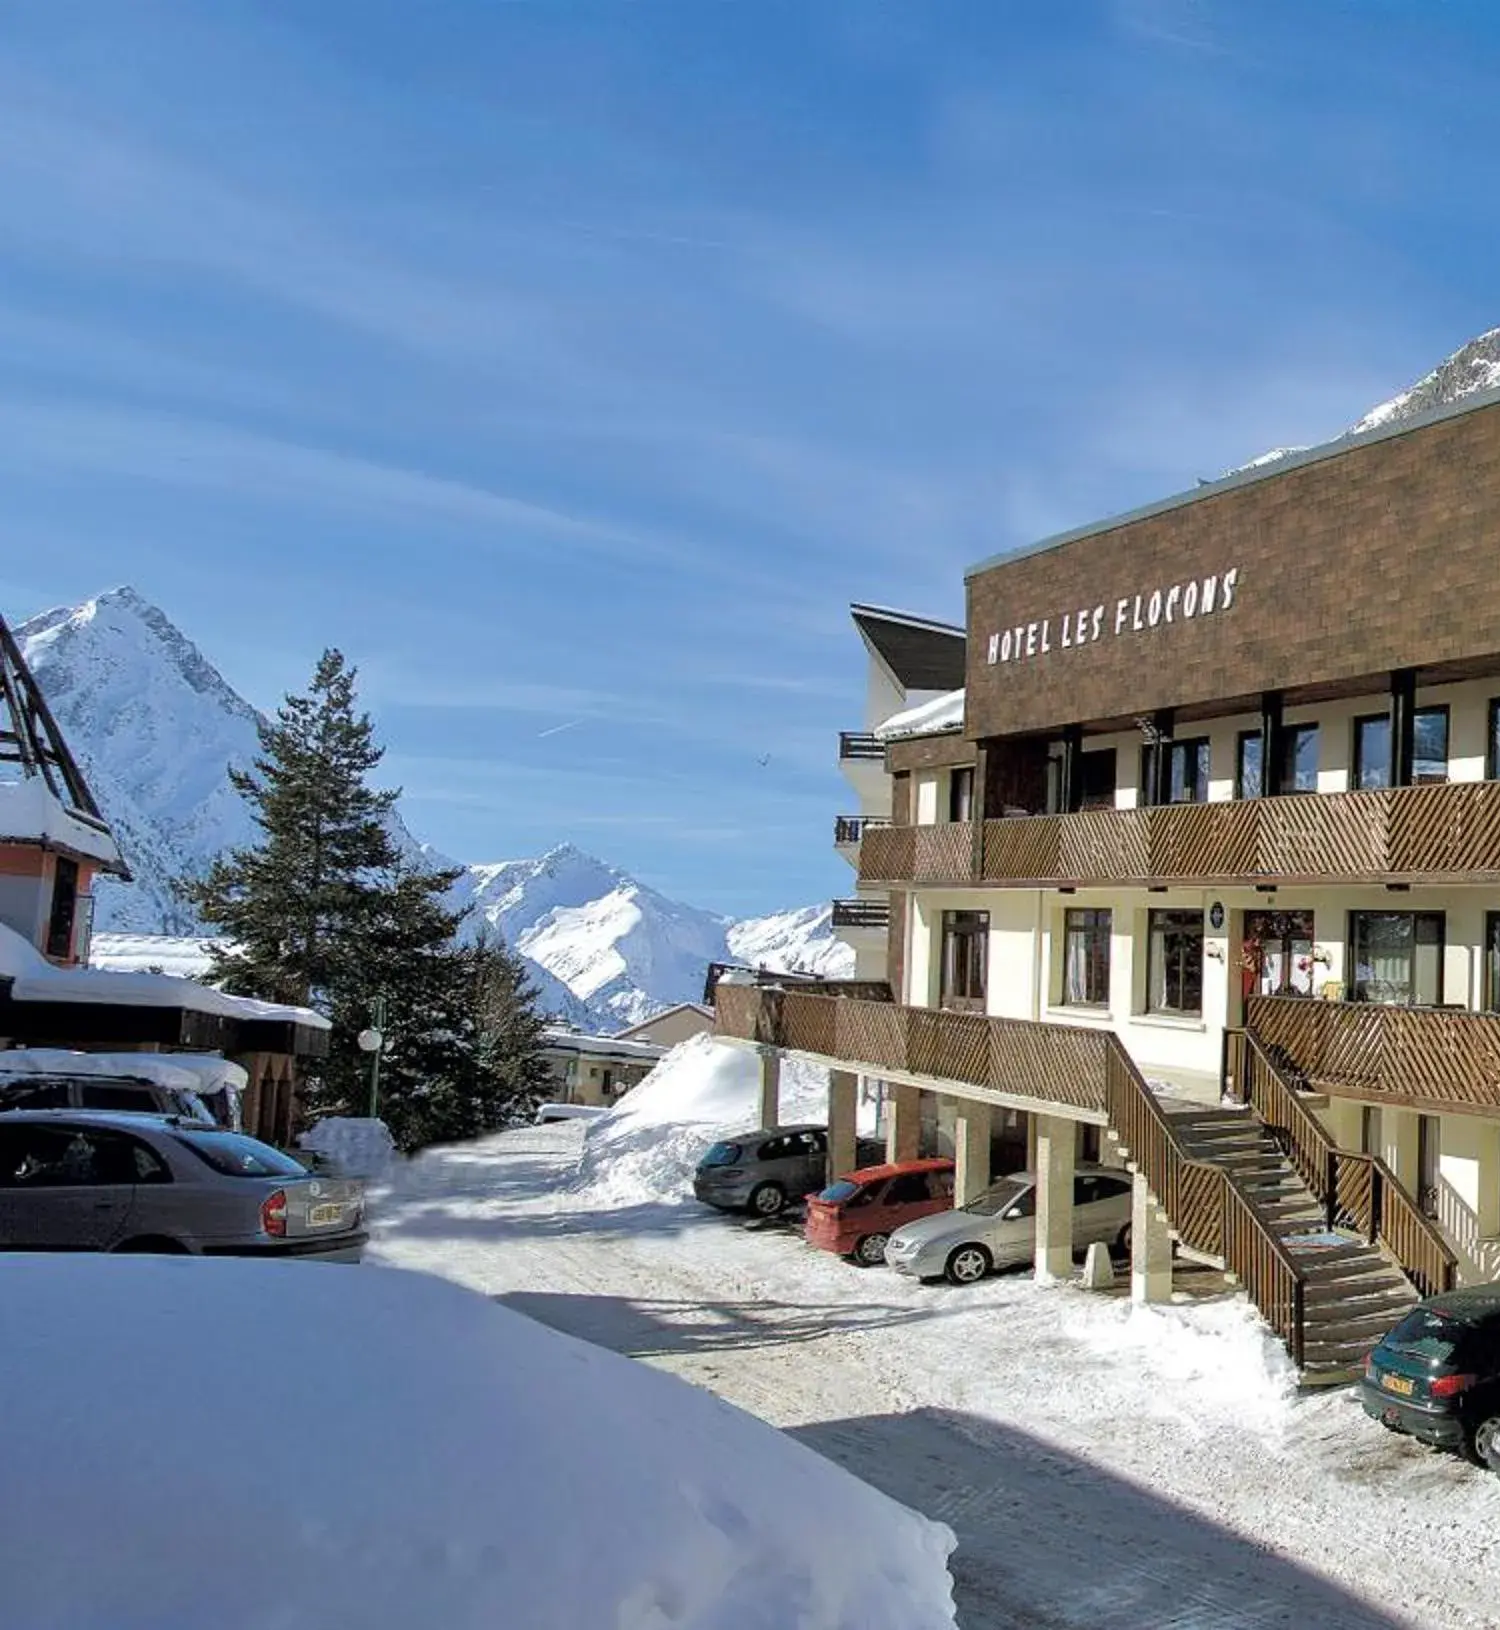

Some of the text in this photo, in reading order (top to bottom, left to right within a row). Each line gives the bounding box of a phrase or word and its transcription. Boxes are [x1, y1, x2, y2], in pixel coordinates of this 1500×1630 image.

[987, 567, 1238, 665] HOTEL LES FLOCONS
